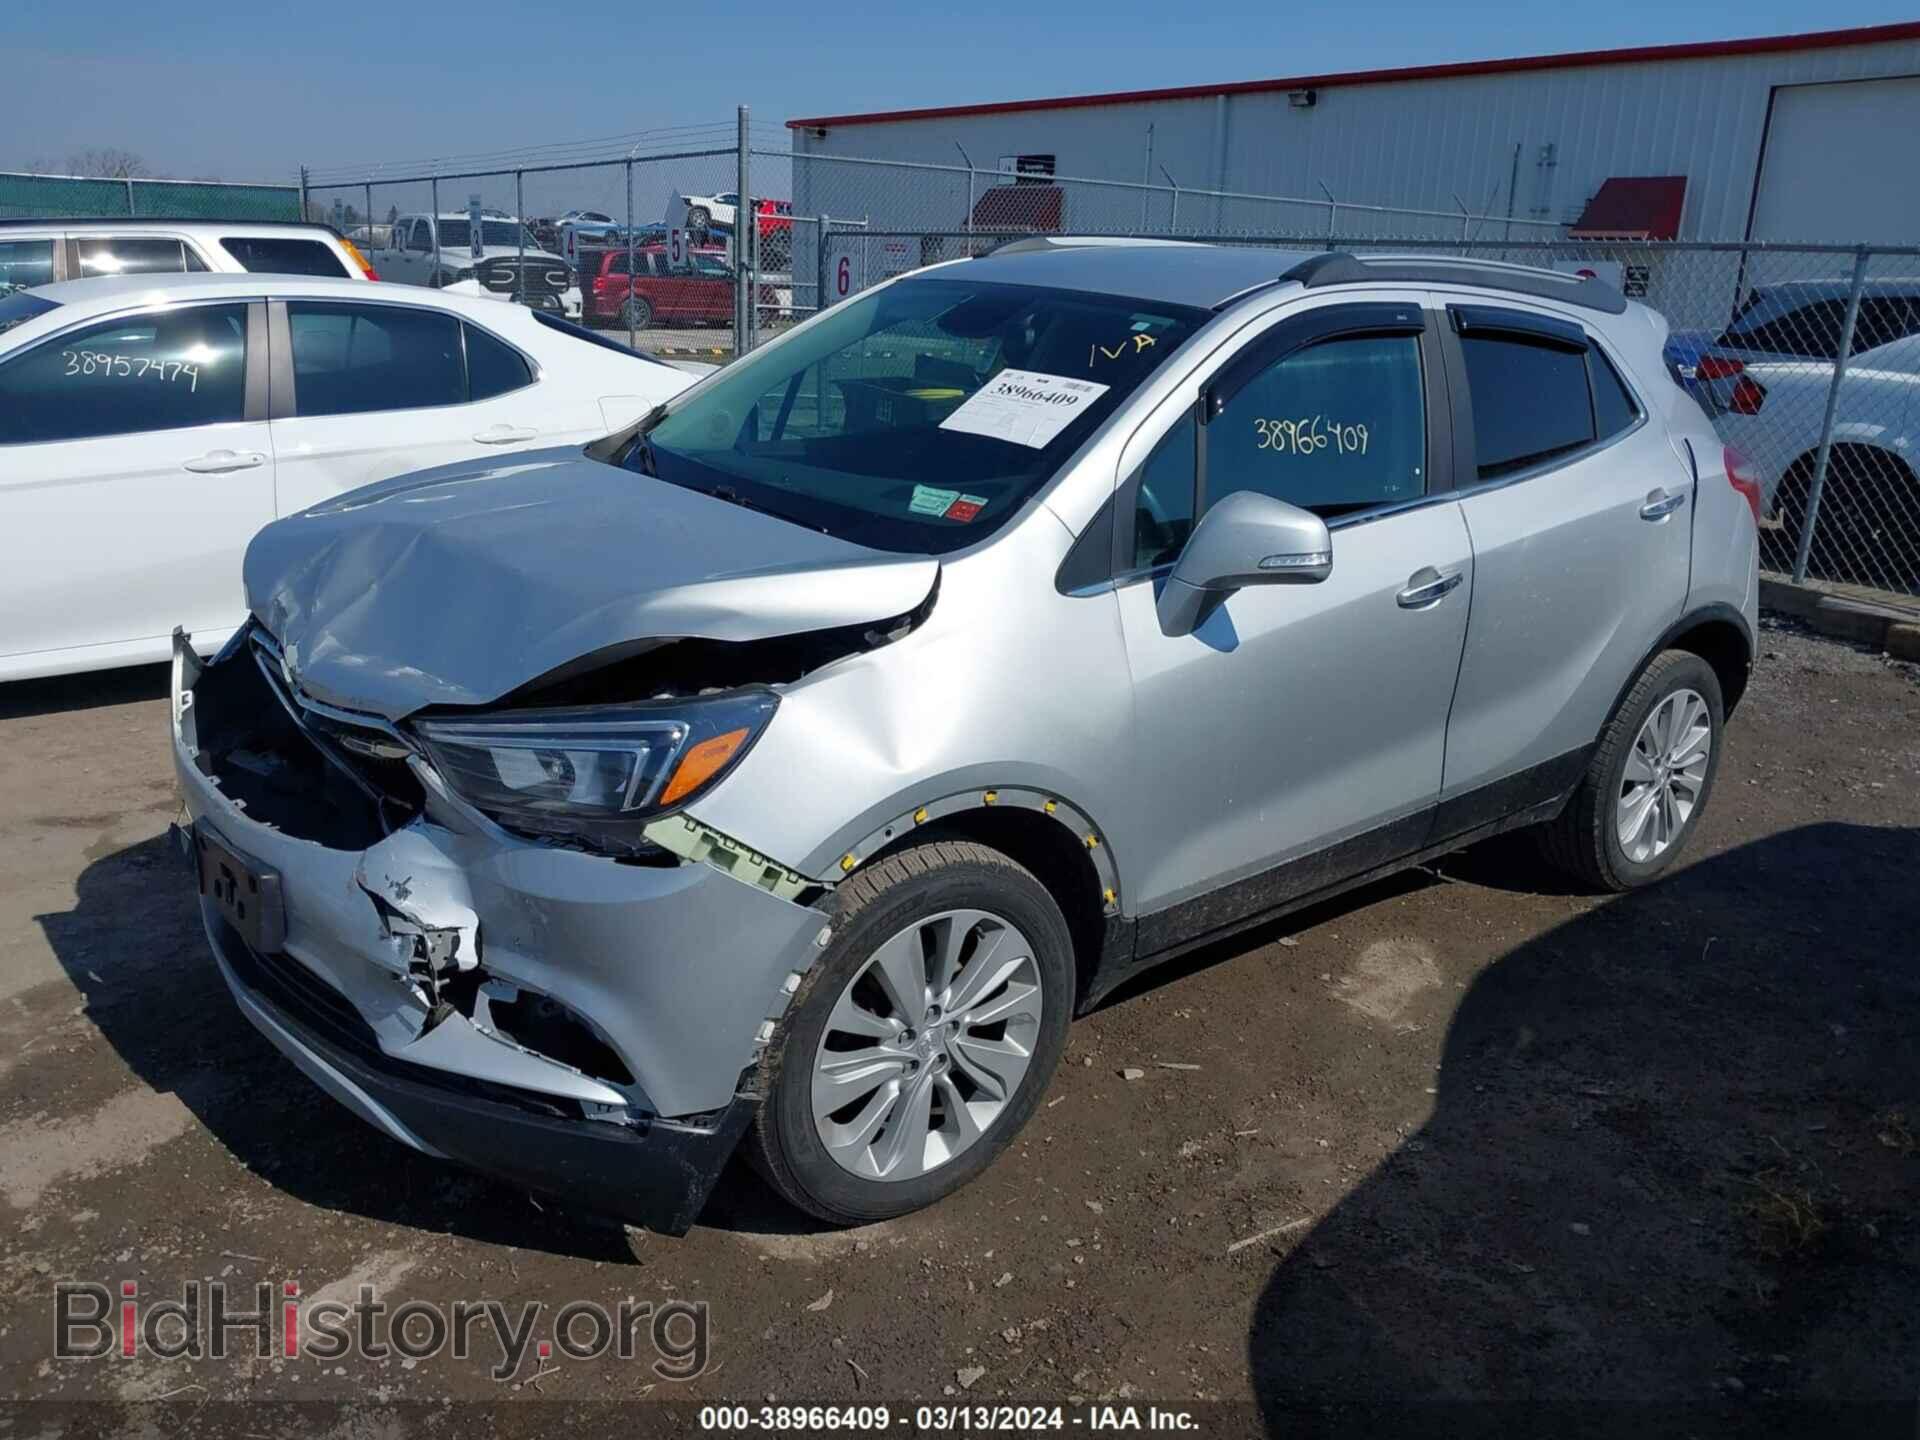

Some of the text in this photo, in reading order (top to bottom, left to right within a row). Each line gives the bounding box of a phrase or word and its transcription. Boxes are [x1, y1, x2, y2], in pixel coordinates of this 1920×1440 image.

[671, 229, 681, 262] 5
[838, 256, 850, 296] 6
[62, 350, 198, 393] 38957474
[989, 382, 1079, 407] 38966409
[1254, 414, 1369, 456] 38966409
